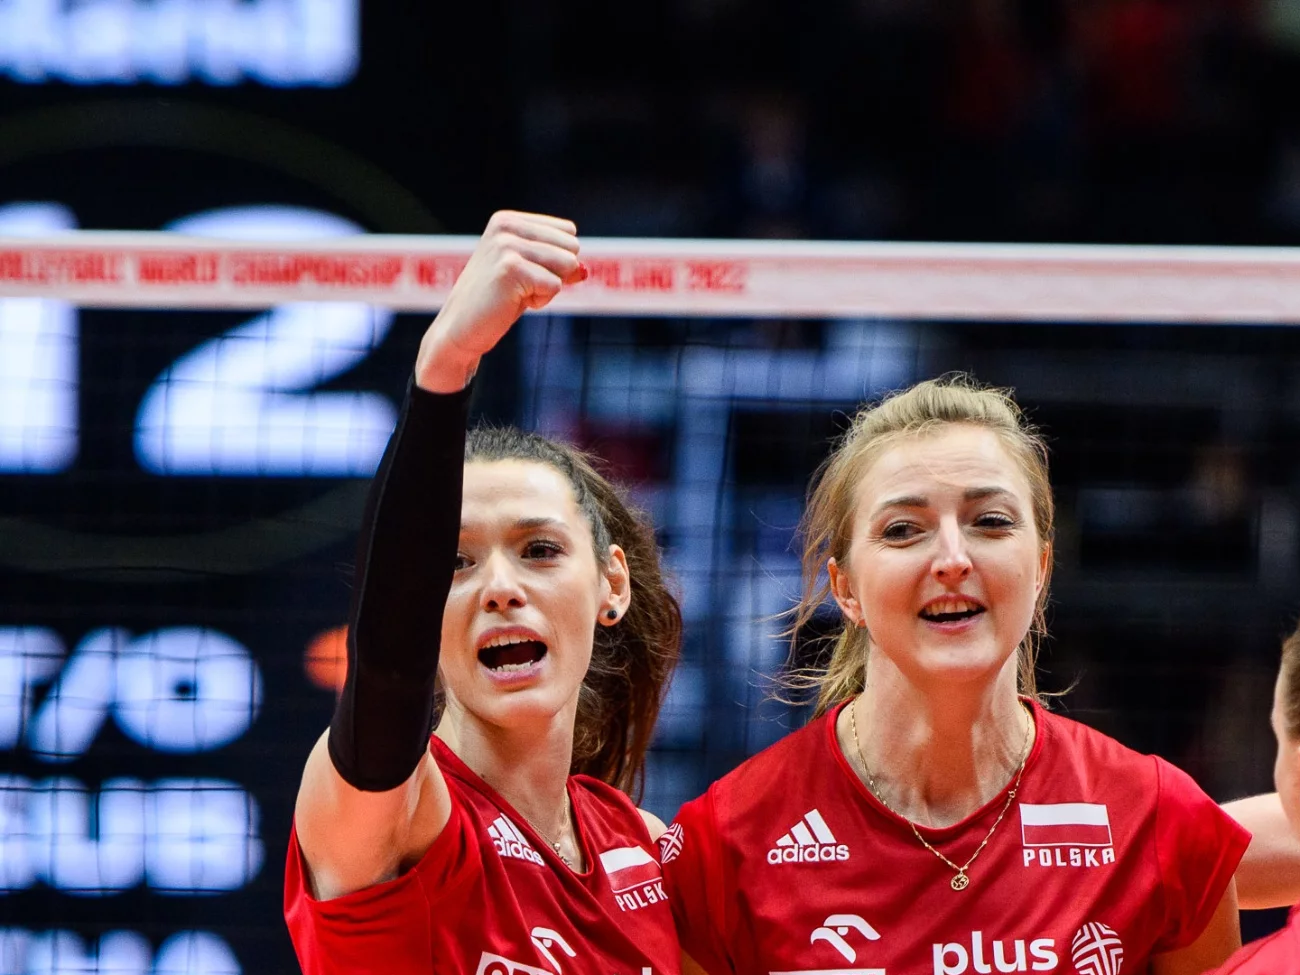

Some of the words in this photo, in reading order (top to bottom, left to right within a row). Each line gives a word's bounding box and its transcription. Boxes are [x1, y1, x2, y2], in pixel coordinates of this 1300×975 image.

[493, 837, 545, 867] didas
[767, 843, 850, 865] adidas
[1023, 847, 1116, 868] POLSKA
[615, 881, 669, 912] POLSK
